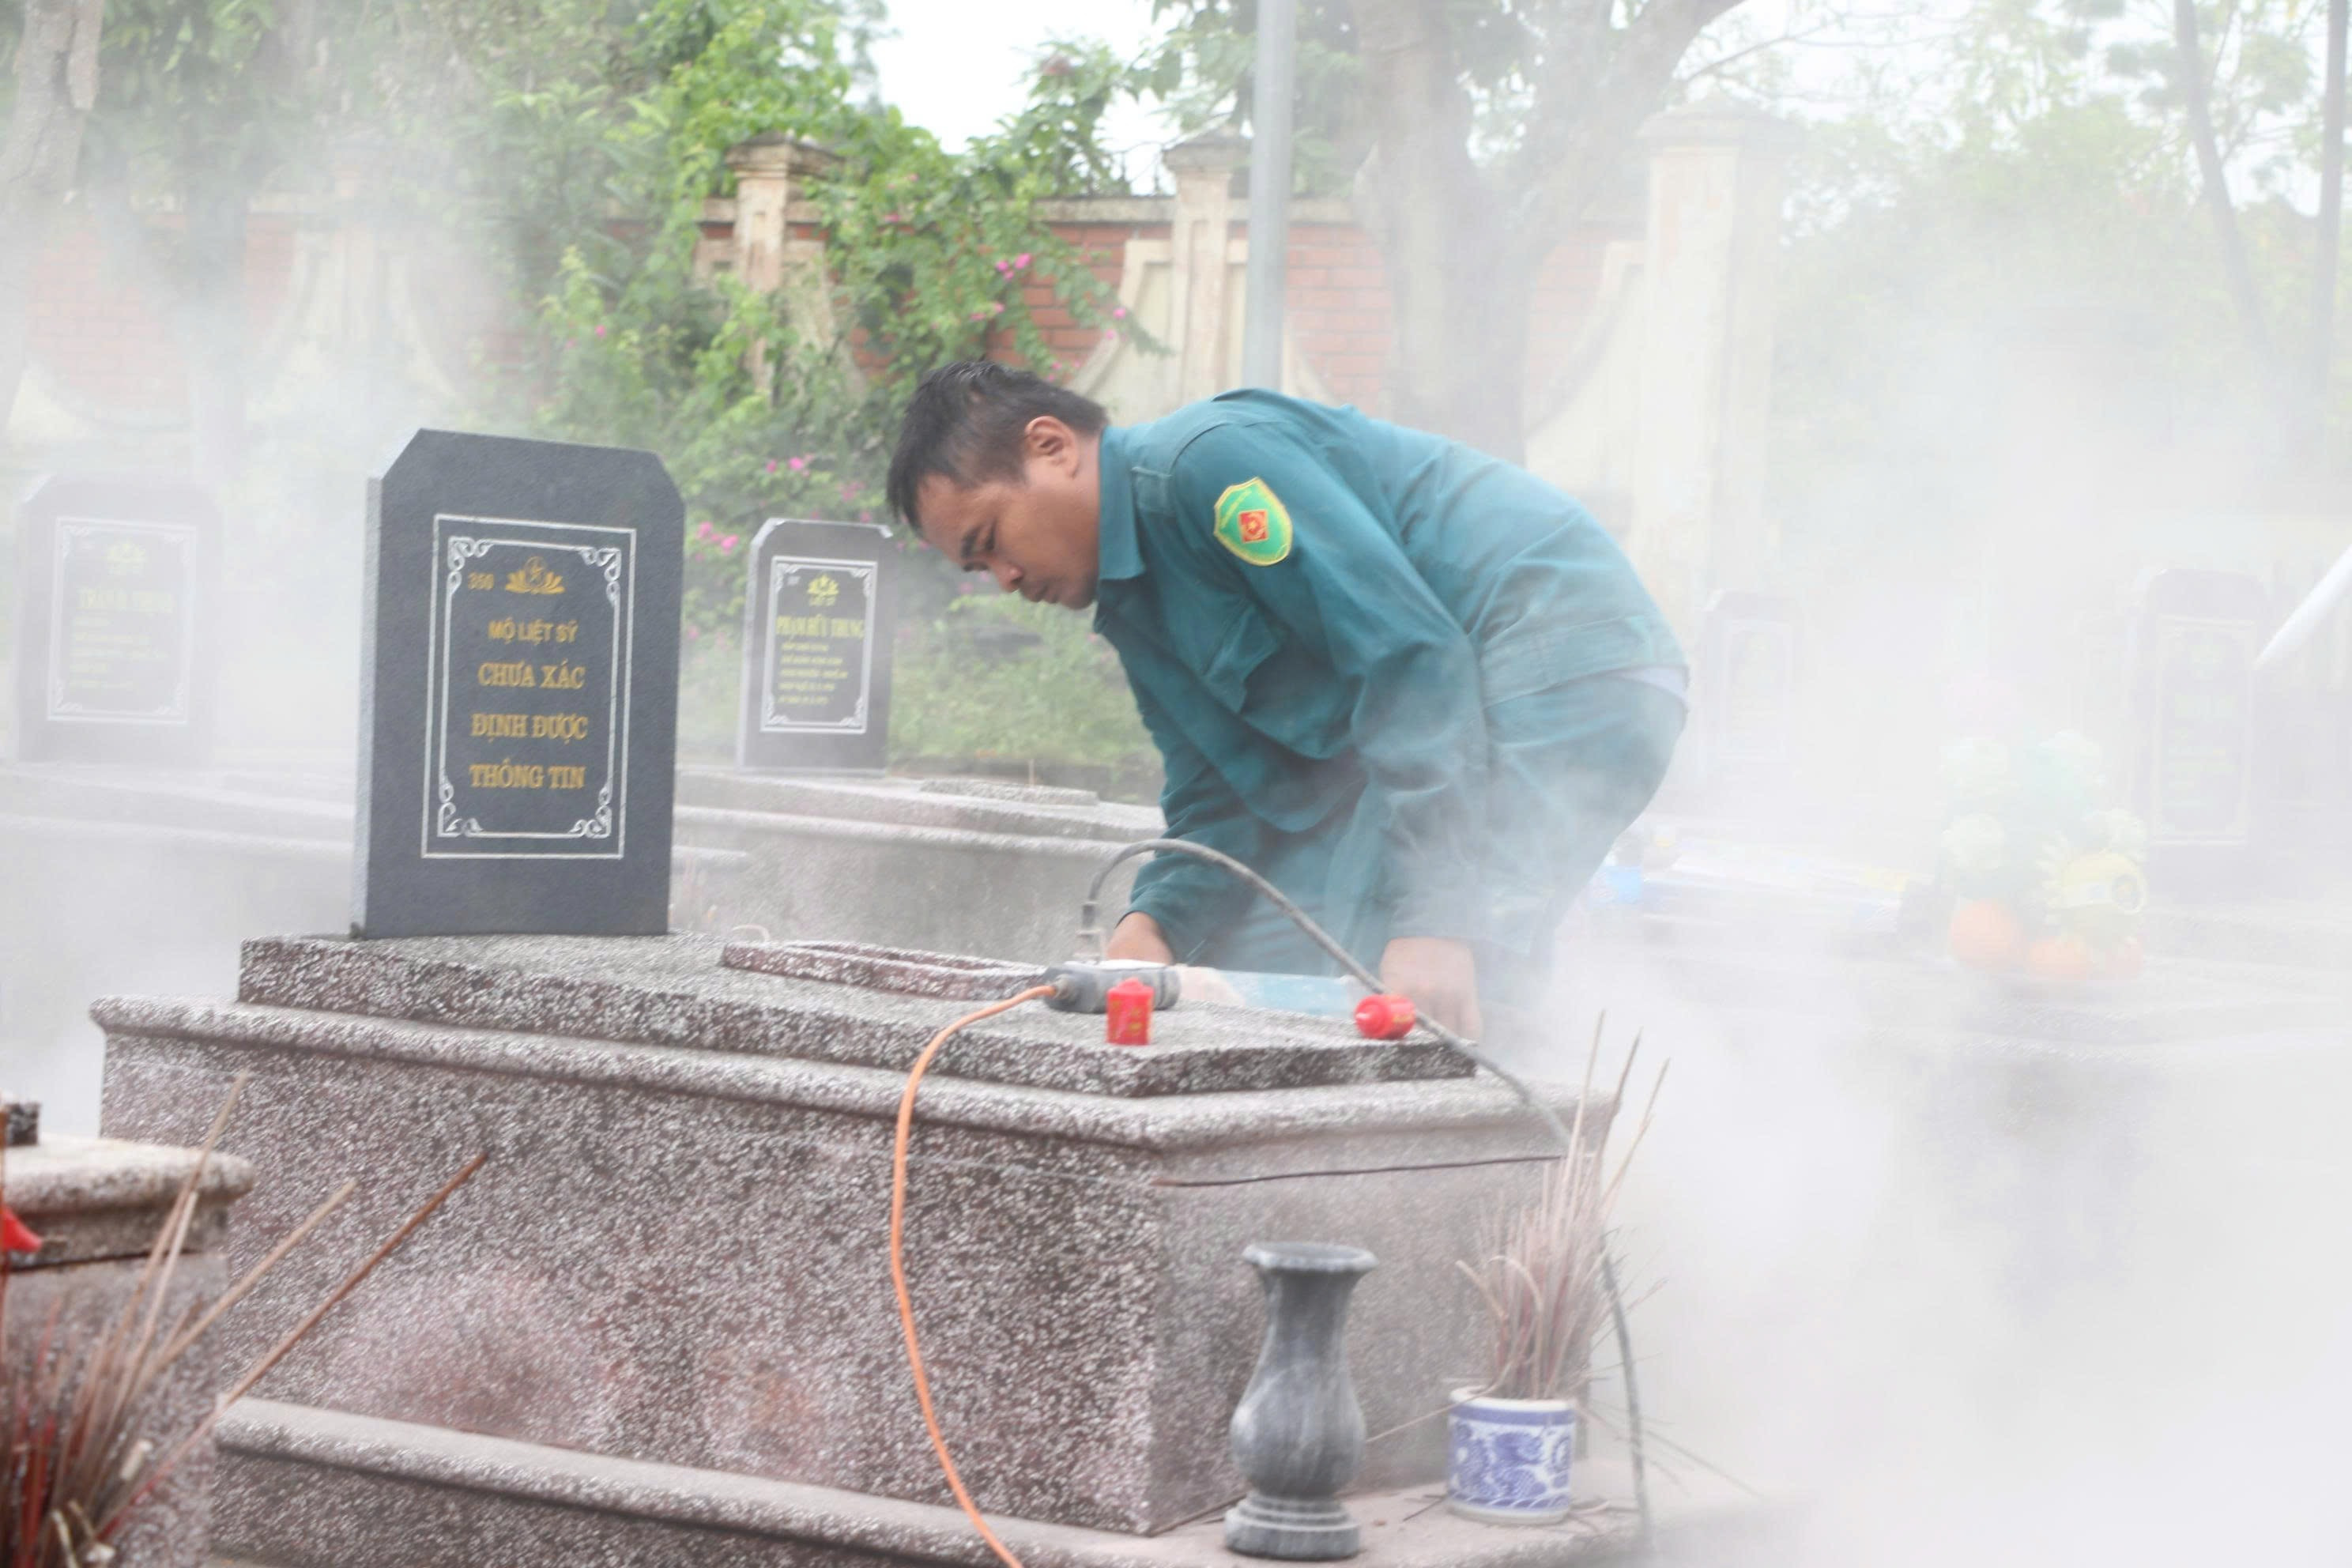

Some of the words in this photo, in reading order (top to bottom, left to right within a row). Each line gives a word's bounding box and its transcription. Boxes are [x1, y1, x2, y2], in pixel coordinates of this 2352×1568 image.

[488, 616, 516, 645] MỘ
[518, 619, 554, 646] LIỆT
[539, 658, 586, 690] XÁC
[470, 713, 528, 743] ĐỊNH
[530, 712, 588, 744] ĐƯỢC
[468, 757, 545, 789] THÔNG
[547, 765, 586, 790] TIN
